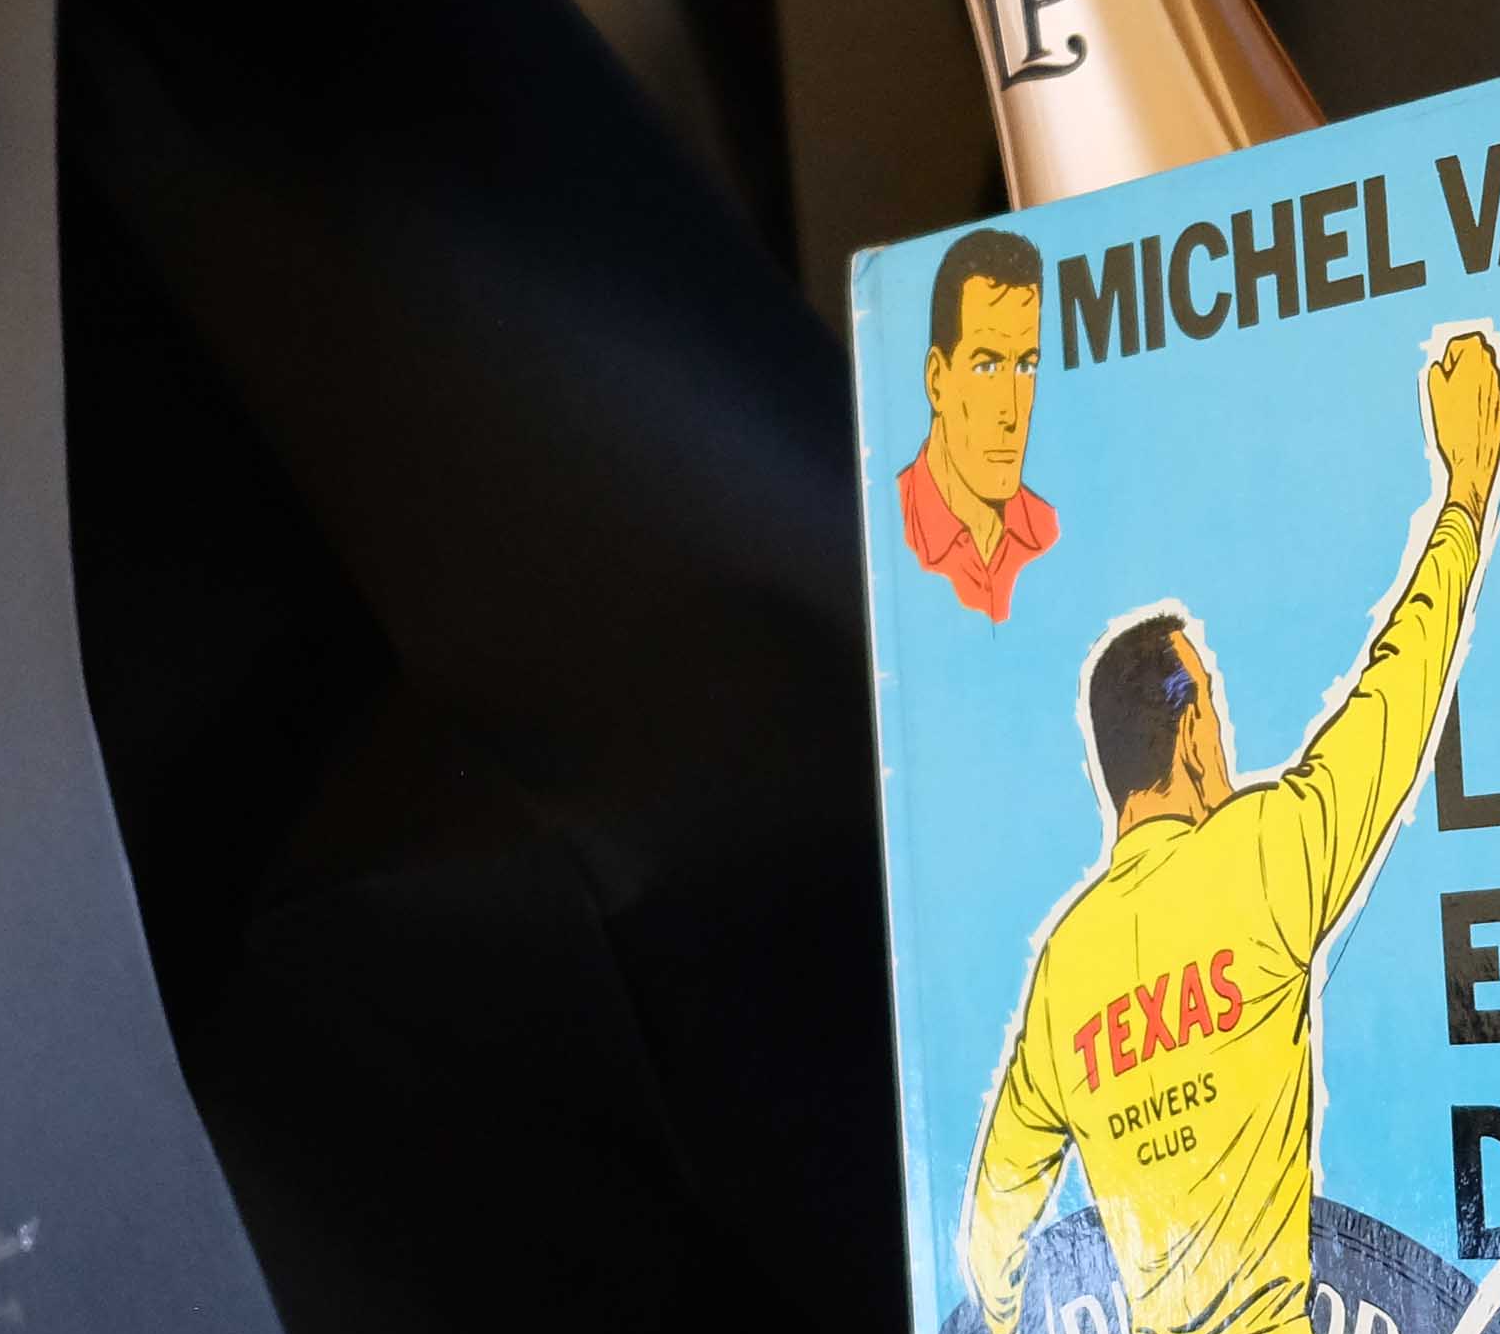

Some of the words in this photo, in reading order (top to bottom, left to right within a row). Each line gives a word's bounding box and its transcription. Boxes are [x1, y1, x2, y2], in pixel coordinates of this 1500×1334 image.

[1058, 175, 1426, 371] MICHEL
[1073, 948, 1243, 1094] TEXAS
[1107, 1072, 1217, 1140] DRIVER'S
[1136, 1125, 1197, 1166] CLUB
